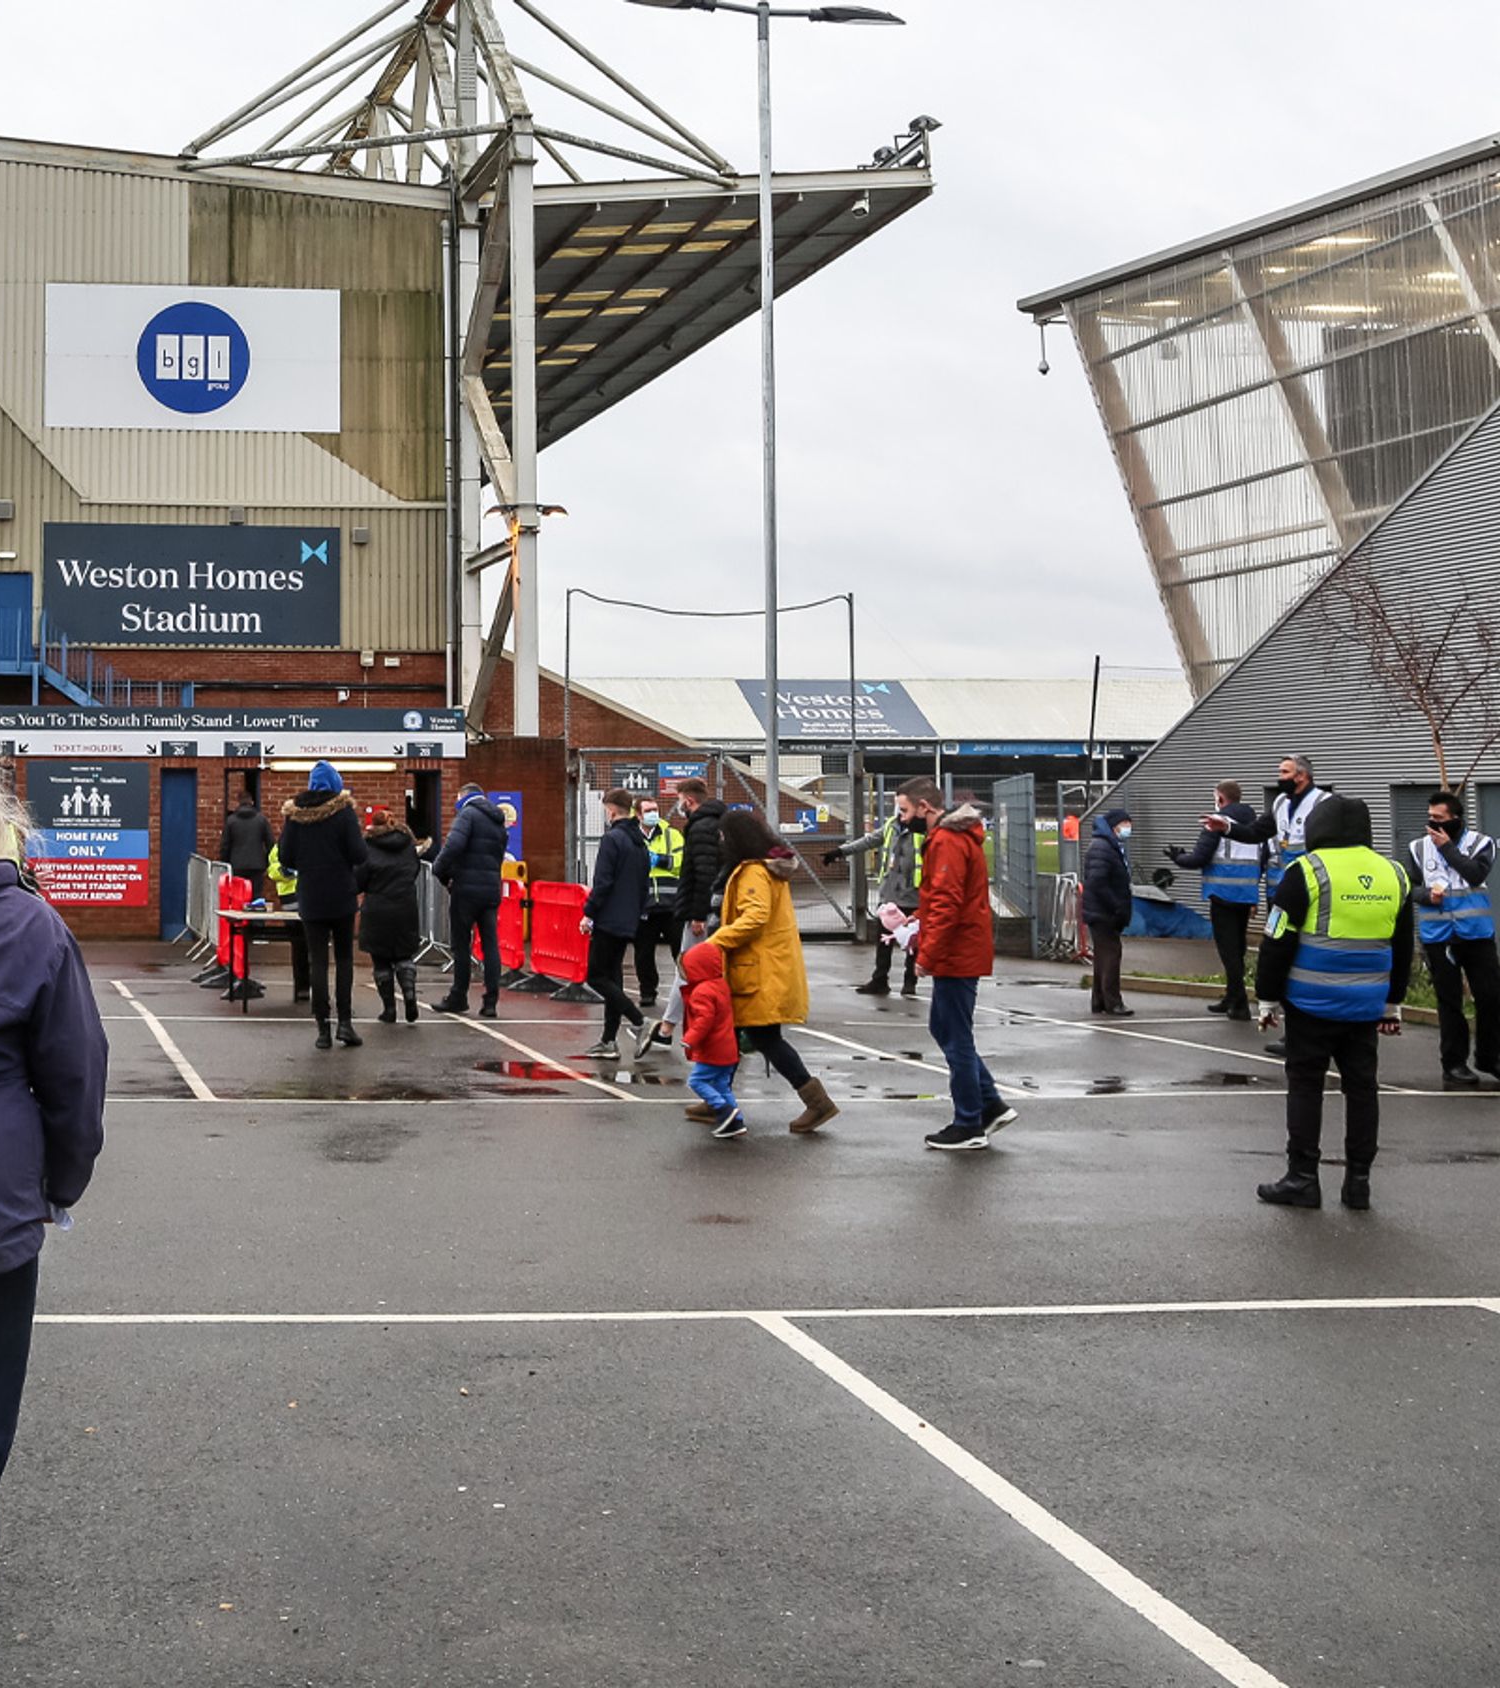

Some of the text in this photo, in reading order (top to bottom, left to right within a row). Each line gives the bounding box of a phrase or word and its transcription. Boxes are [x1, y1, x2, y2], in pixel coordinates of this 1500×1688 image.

[56, 559, 304, 591] Weston Homes
[121, 602, 263, 634] Stadium
[776, 705, 885, 720] Homes
[18, 712, 44, 726] You
[47, 713, 66, 726] To
[68, 713, 97, 727] The
[99, 713, 140, 727] South
[144, 714, 191, 730] Family
[191, 714, 232, 728] Stand
[243, 714, 287, 728] Lower
[288, 714, 320, 728] Tier
[53, 744, 81, 753] TICKET
[330, 745, 369, 754] HOLDERS
[56, 831, 119, 842] HOME FANS
[68, 845, 107, 857] ONLY
[73, 864, 95, 872] FANS
[84, 873, 104, 881] FACE
[73, 882, 87, 891] THE
[88, 882, 128, 891] STADIUM
[49, 892, 89, 901] WITHOUT
